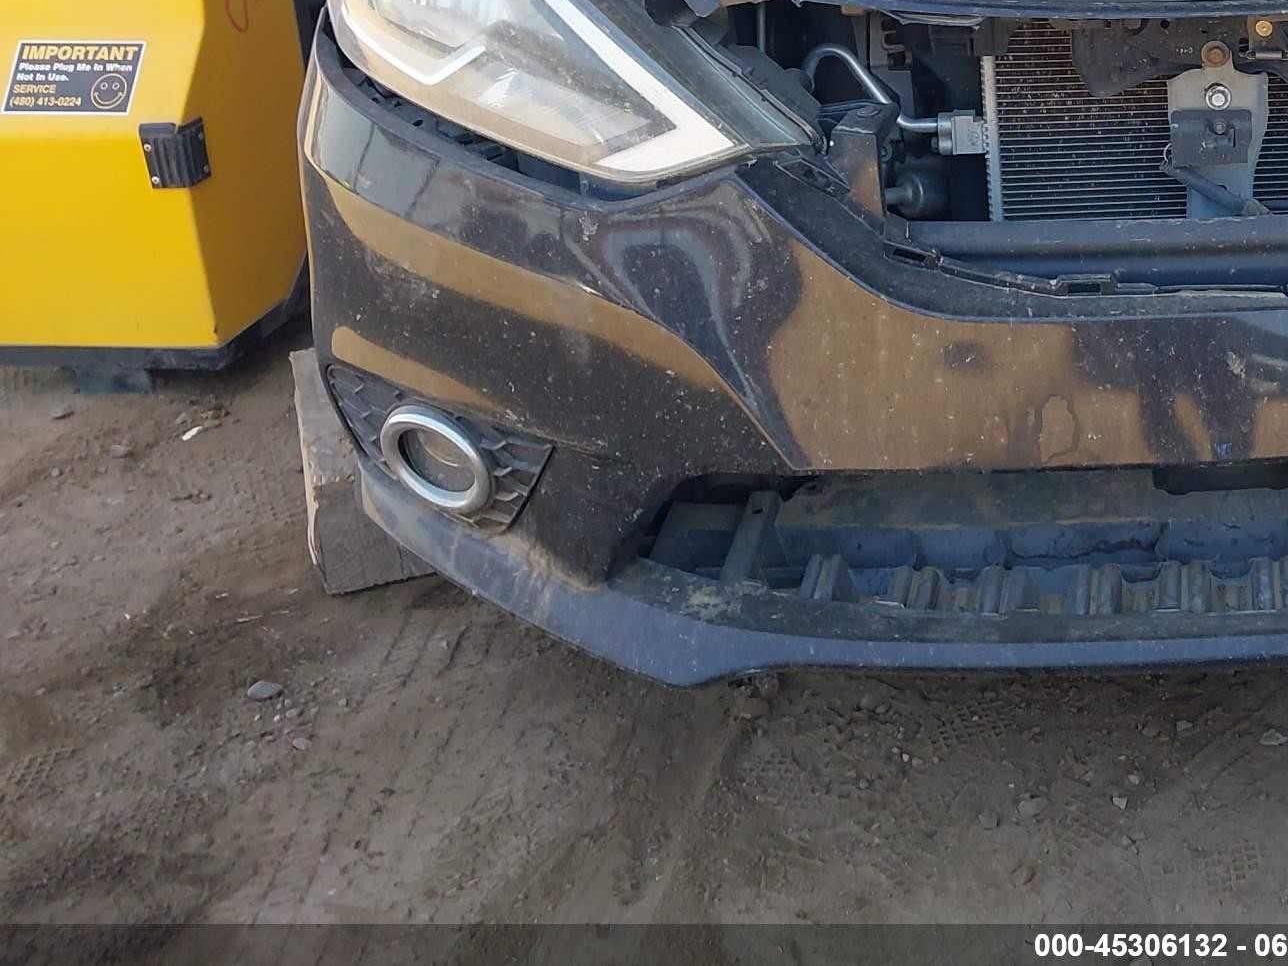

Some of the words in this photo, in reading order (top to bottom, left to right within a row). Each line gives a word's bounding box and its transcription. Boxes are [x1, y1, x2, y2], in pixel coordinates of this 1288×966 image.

[22, 45, 139, 61] IMPORTANT
[19, 62, 50, 71] Please
[53, 62, 74, 72] Plug
[76, 62, 91, 72] Me
[93, 63, 104, 72] In
[106, 63, 132, 72] When
[16, 73, 34, 81] Not
[48, 74, 69, 82] Use.
[13, 84, 56, 94] SERVICE
[10, 96, 34, 107] (480)
[36, 96, 82, 106] 413-0224
